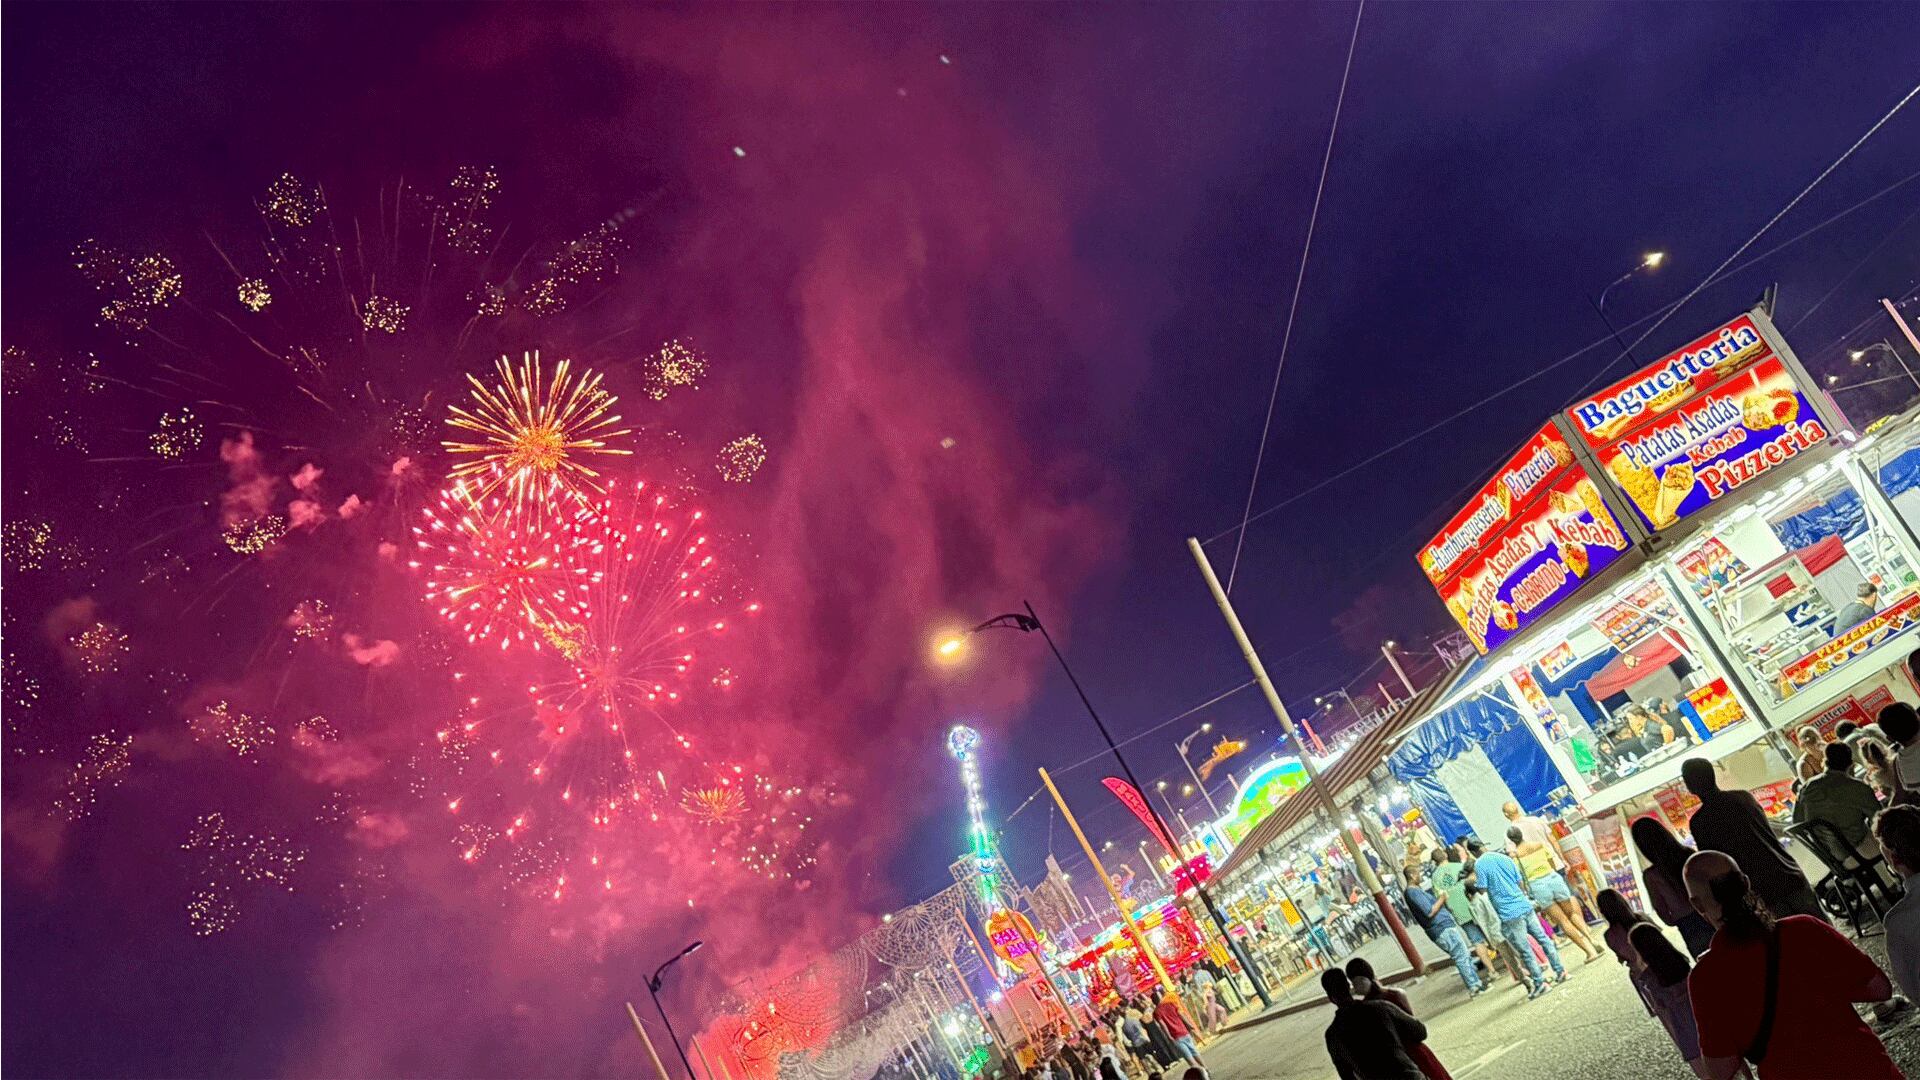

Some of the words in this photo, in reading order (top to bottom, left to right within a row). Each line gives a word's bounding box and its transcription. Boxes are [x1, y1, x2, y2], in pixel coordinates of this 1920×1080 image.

[1578, 328, 1758, 430] Baguetteria
[1621, 425, 1687, 470] Patatas
[1680, 395, 1741, 440] Asadas
[1687, 427, 1747, 466] Kebab
[1698, 421, 1827, 498] Pizzeria
[1505, 446, 1557, 499] Pizzeria
[1468, 577, 1499, 643] Patatas
[1486, 536, 1532, 581] Asadas
[1524, 523, 1544, 549] Y
[1548, 517, 1618, 547] Kebab
[1816, 615, 1887, 660] PIZZERIA
